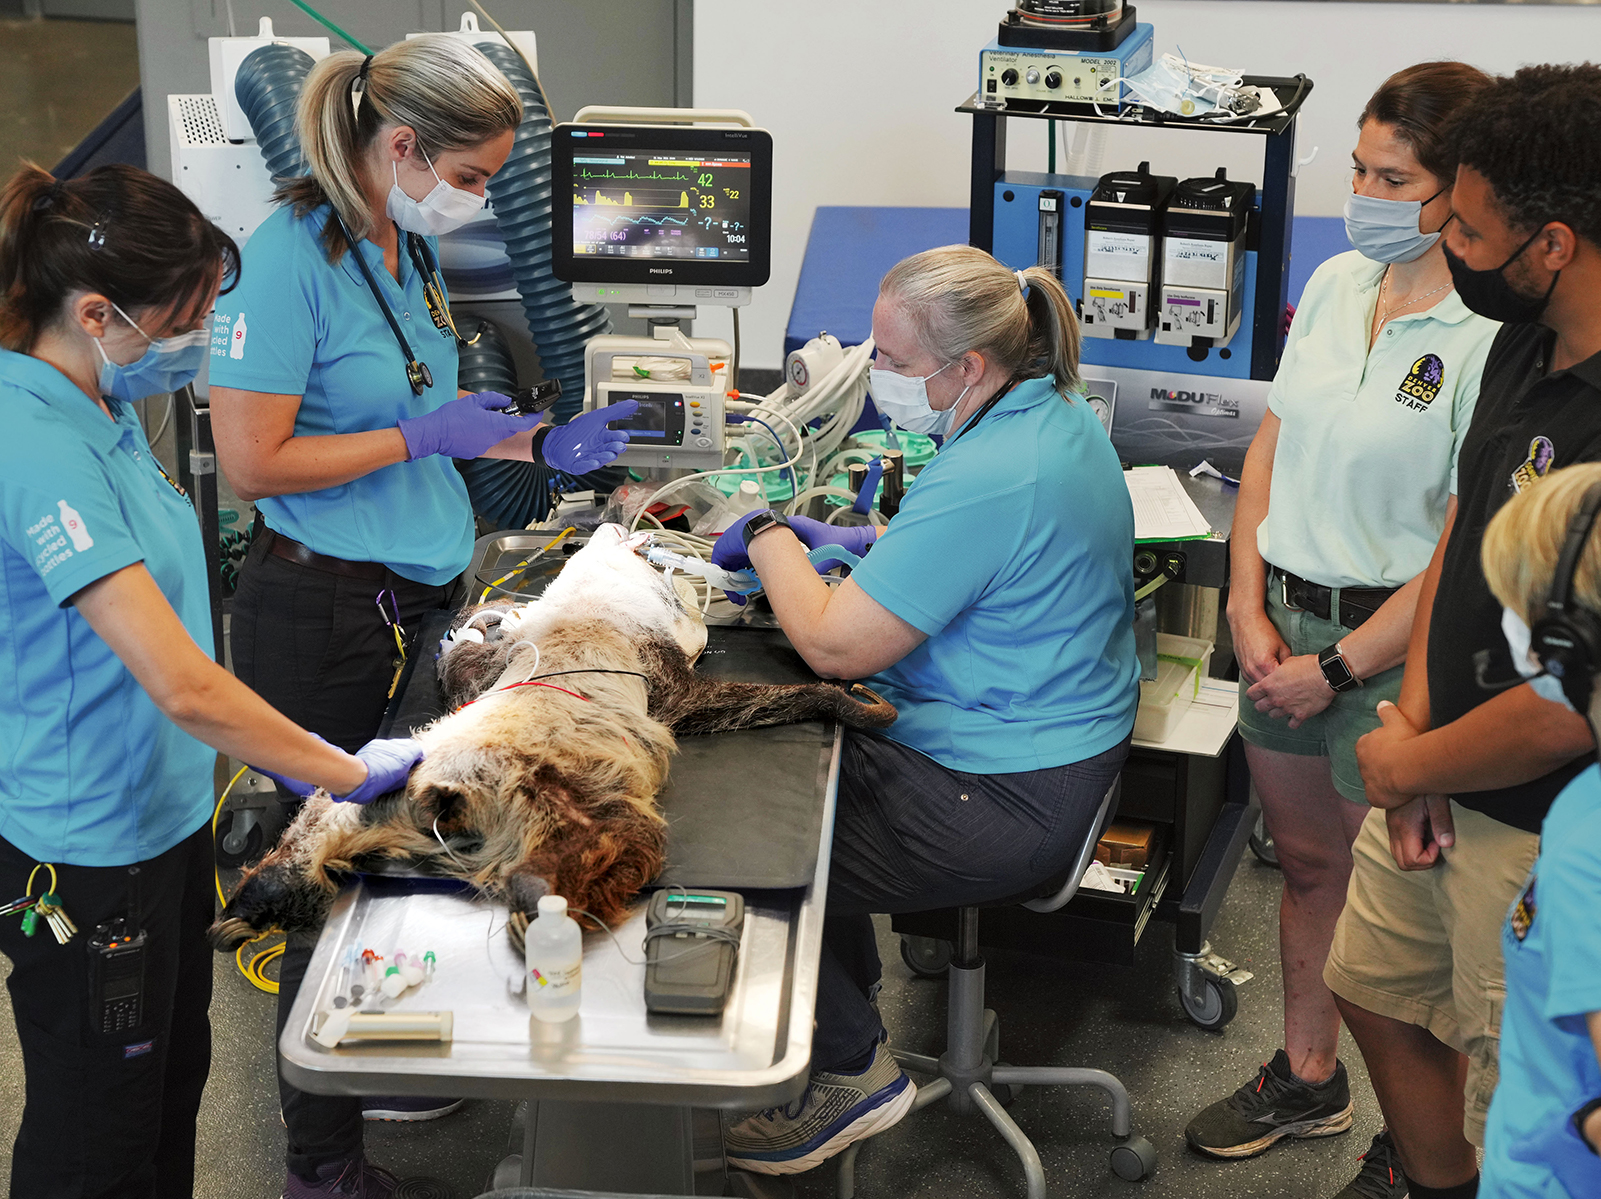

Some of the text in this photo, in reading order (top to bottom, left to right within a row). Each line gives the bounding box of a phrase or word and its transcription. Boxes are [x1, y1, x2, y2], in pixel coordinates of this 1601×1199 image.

[697, 173, 714, 188] 42
[699, 194, 715, 209] 33
[729, 190, 740, 200] 22
[609, 231, 626, 241] (64)
[726, 234, 746, 244] 10:04
[235, 330, 243, 340] 9
[1401, 380, 1435, 402] ZOO
[1407, 375, 1437, 393] DENVER
[1395, 392, 1429, 413] STAFF
[26, 514, 55, 538] Made
[68, 519, 78, 530] 9
[36, 525, 61, 546] with
